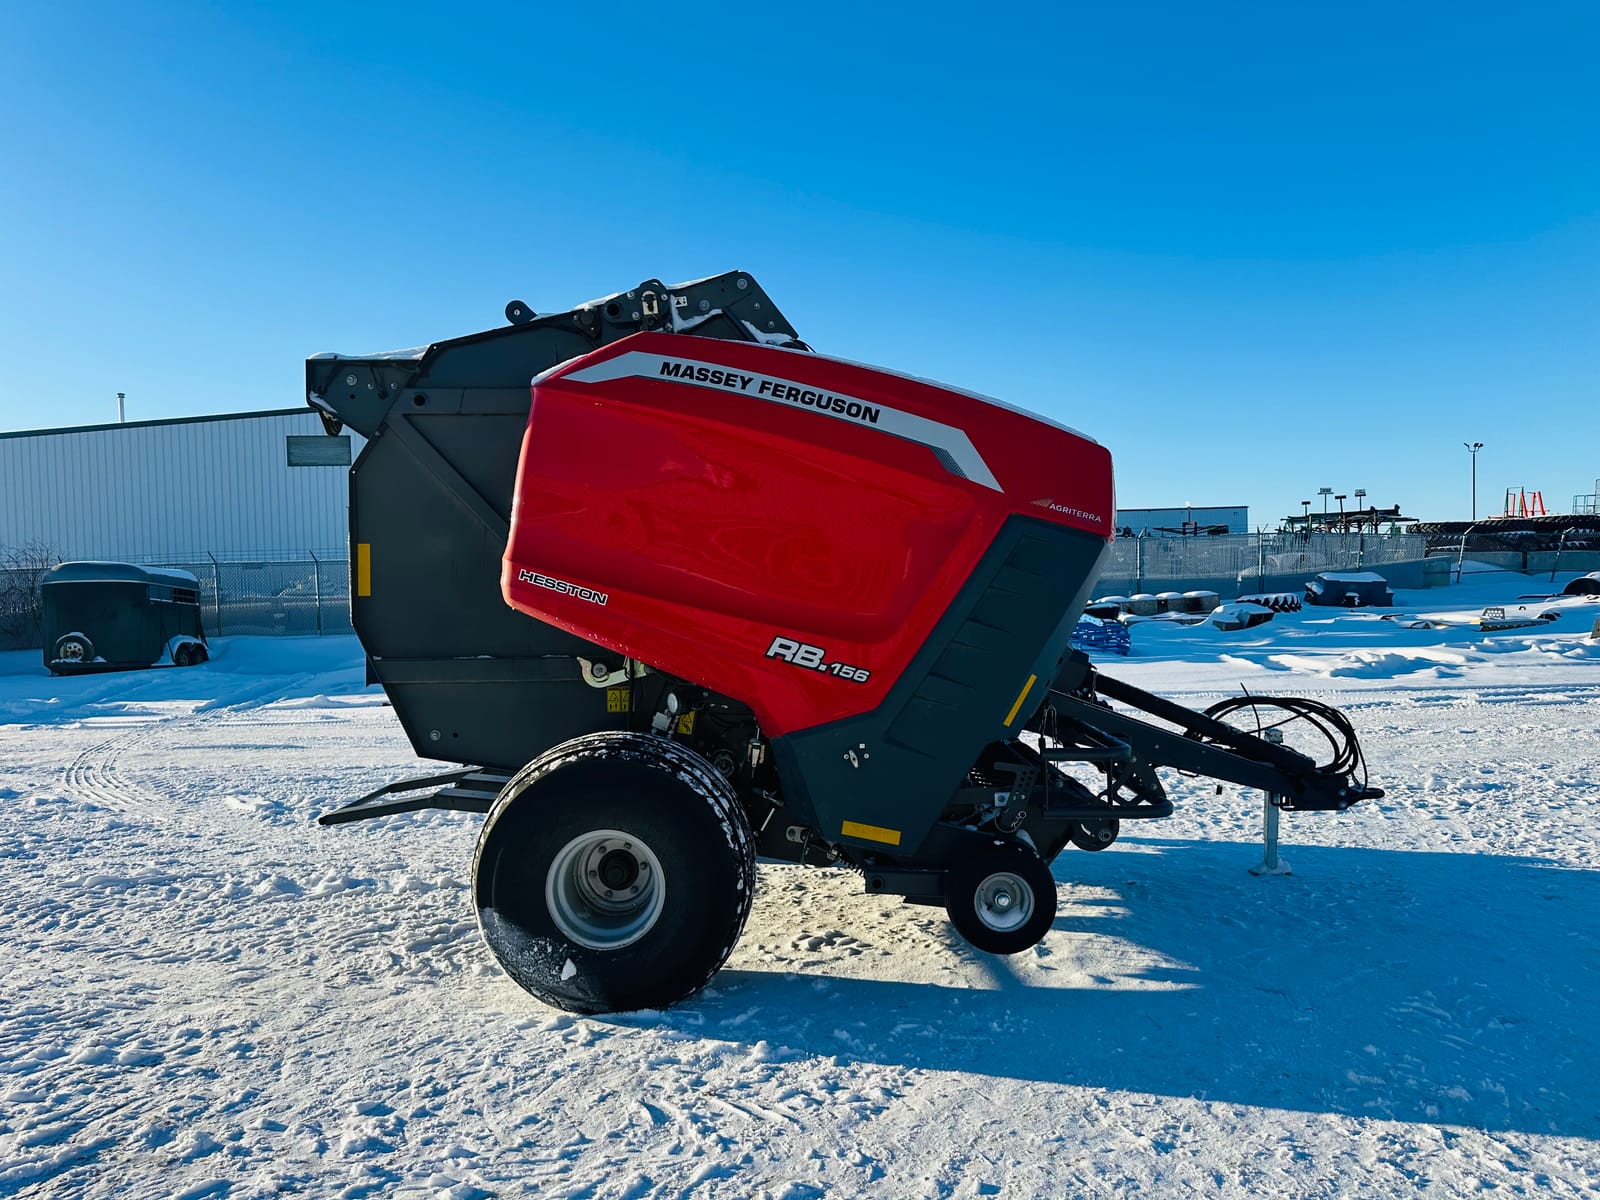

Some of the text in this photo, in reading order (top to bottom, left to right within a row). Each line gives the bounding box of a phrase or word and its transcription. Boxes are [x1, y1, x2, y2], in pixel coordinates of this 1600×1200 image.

[660, 361, 881, 424] MASSEY FERGUSON
[1049, 503, 1101, 522] AGRITERRA
[519, 569, 608, 605] HESSTON
